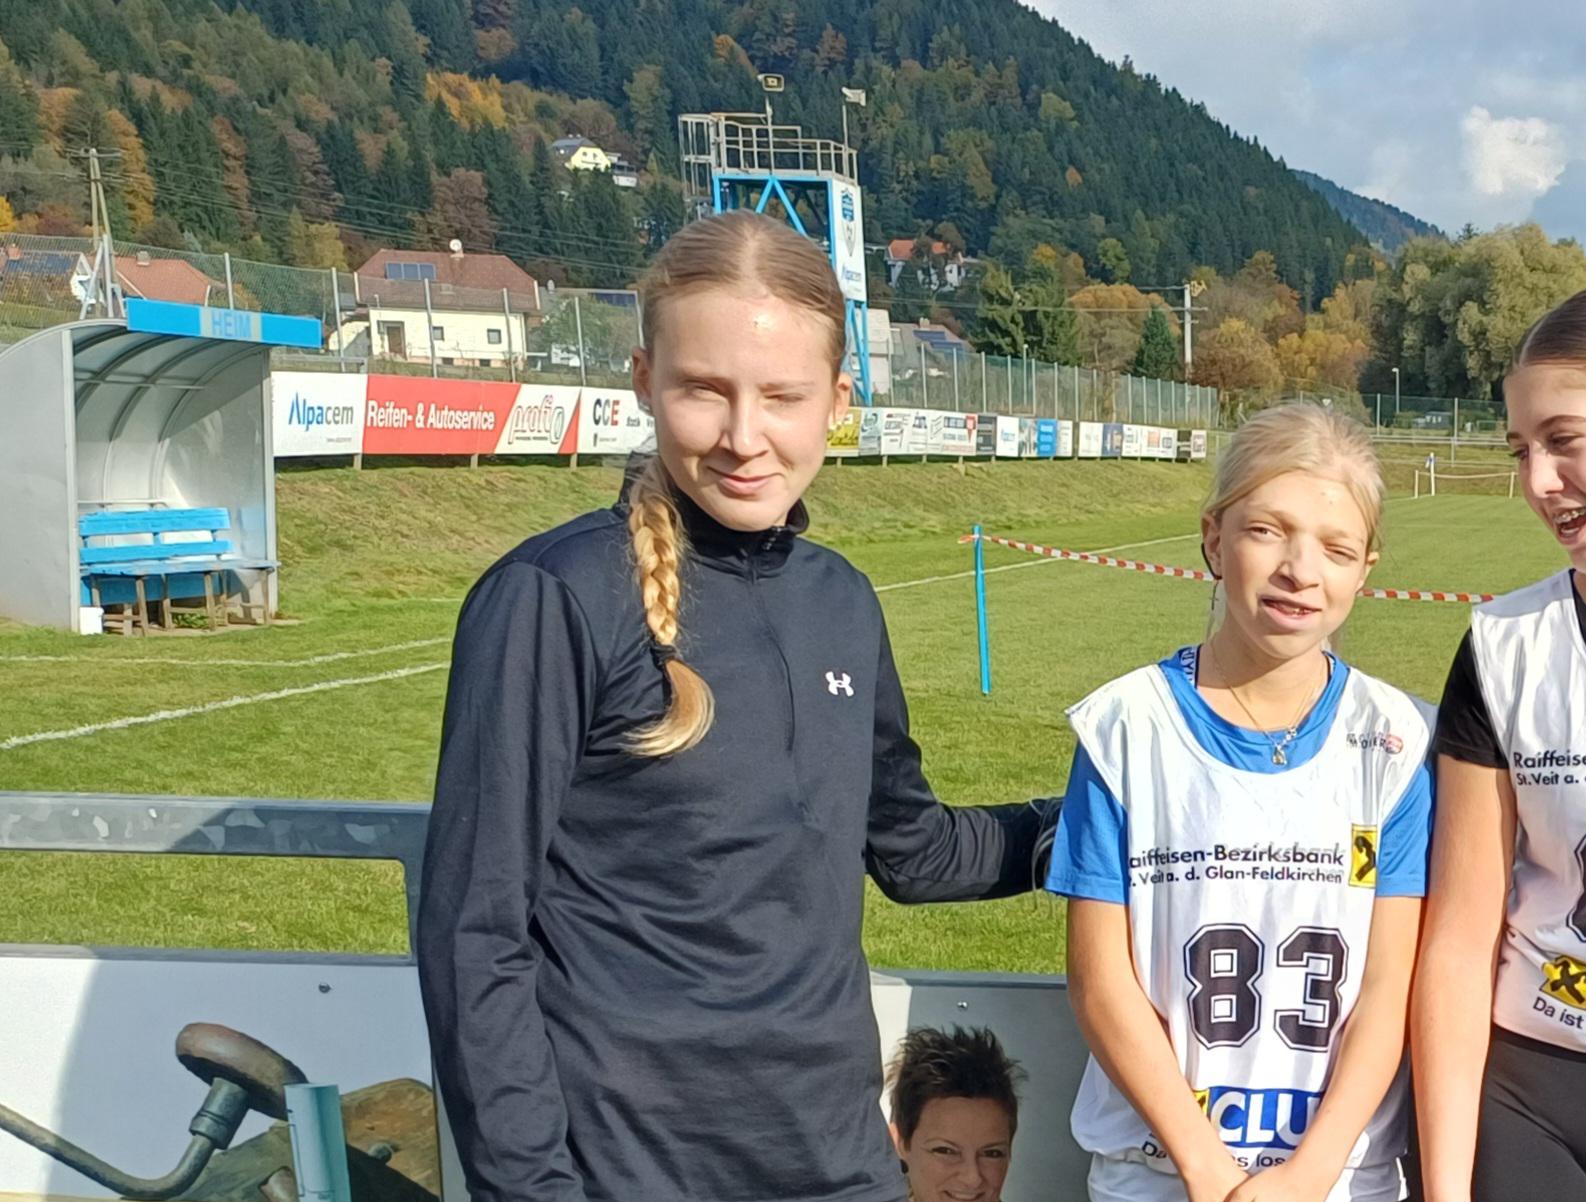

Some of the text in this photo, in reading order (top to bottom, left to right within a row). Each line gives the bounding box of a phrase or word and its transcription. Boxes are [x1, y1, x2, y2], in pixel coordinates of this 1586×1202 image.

[211, 309, 252, 338] HEIM
[288, 391, 354, 432] Alpacem
[367, 400, 495, 431] Reifen- & Autoservice
[593, 398, 620, 427] CCE
[1129, 844, 1344, 869] aiffeisen-Bezirksbank
[1185, 866, 1200, 881] d.
[1205, 865, 1342, 884] Glan-Feldkirchen
[1183, 923, 1349, 1053] 83
[1532, 996, 1556, 1018] Da
[1559, 1008, 1584, 1030] ist
[1210, 1091, 1322, 1146] CLU
